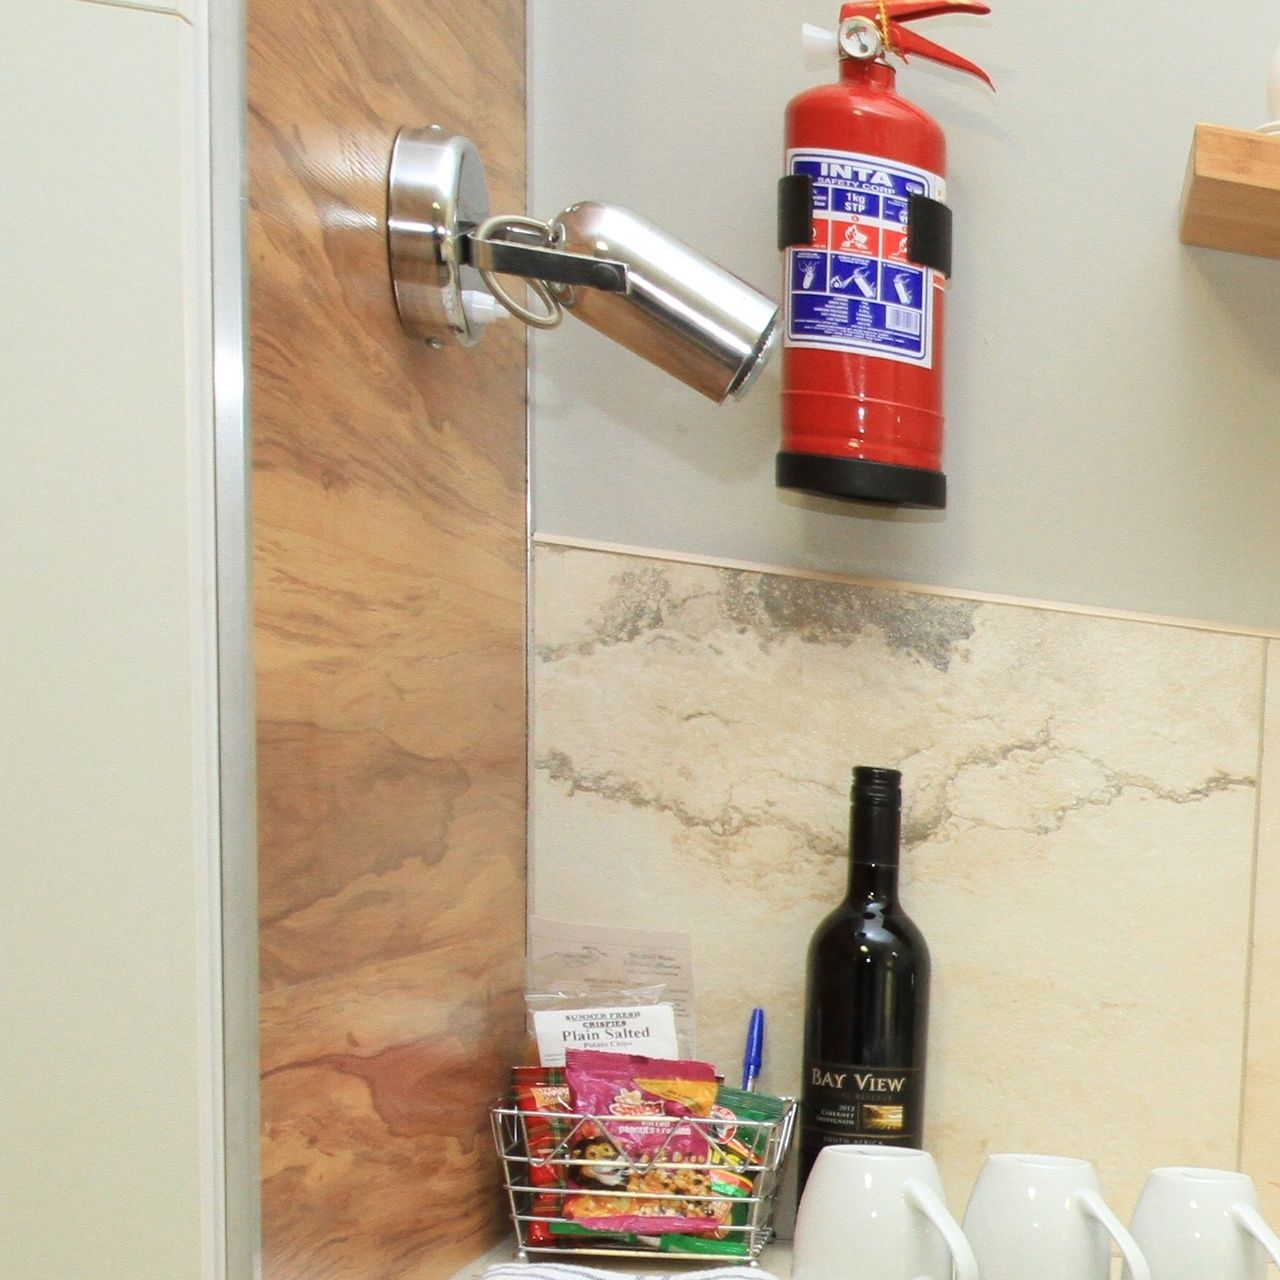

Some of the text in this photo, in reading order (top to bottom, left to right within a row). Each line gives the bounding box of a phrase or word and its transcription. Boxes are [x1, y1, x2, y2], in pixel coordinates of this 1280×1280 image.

[820, 163, 894, 188] INTA
[817, 177, 860, 188] SAFETY
[862, 183, 896, 195] CORP
[846, 192, 866, 204] 1kg
[845, 202, 866, 213] STP
[565, 1011, 641, 1021] SUMMER FRESH
[582, 1020, 627, 1029] CRISPIES
[562, 1026, 650, 1042] Plain Salted
[811, 1067, 906, 1092] BAY VIEW
